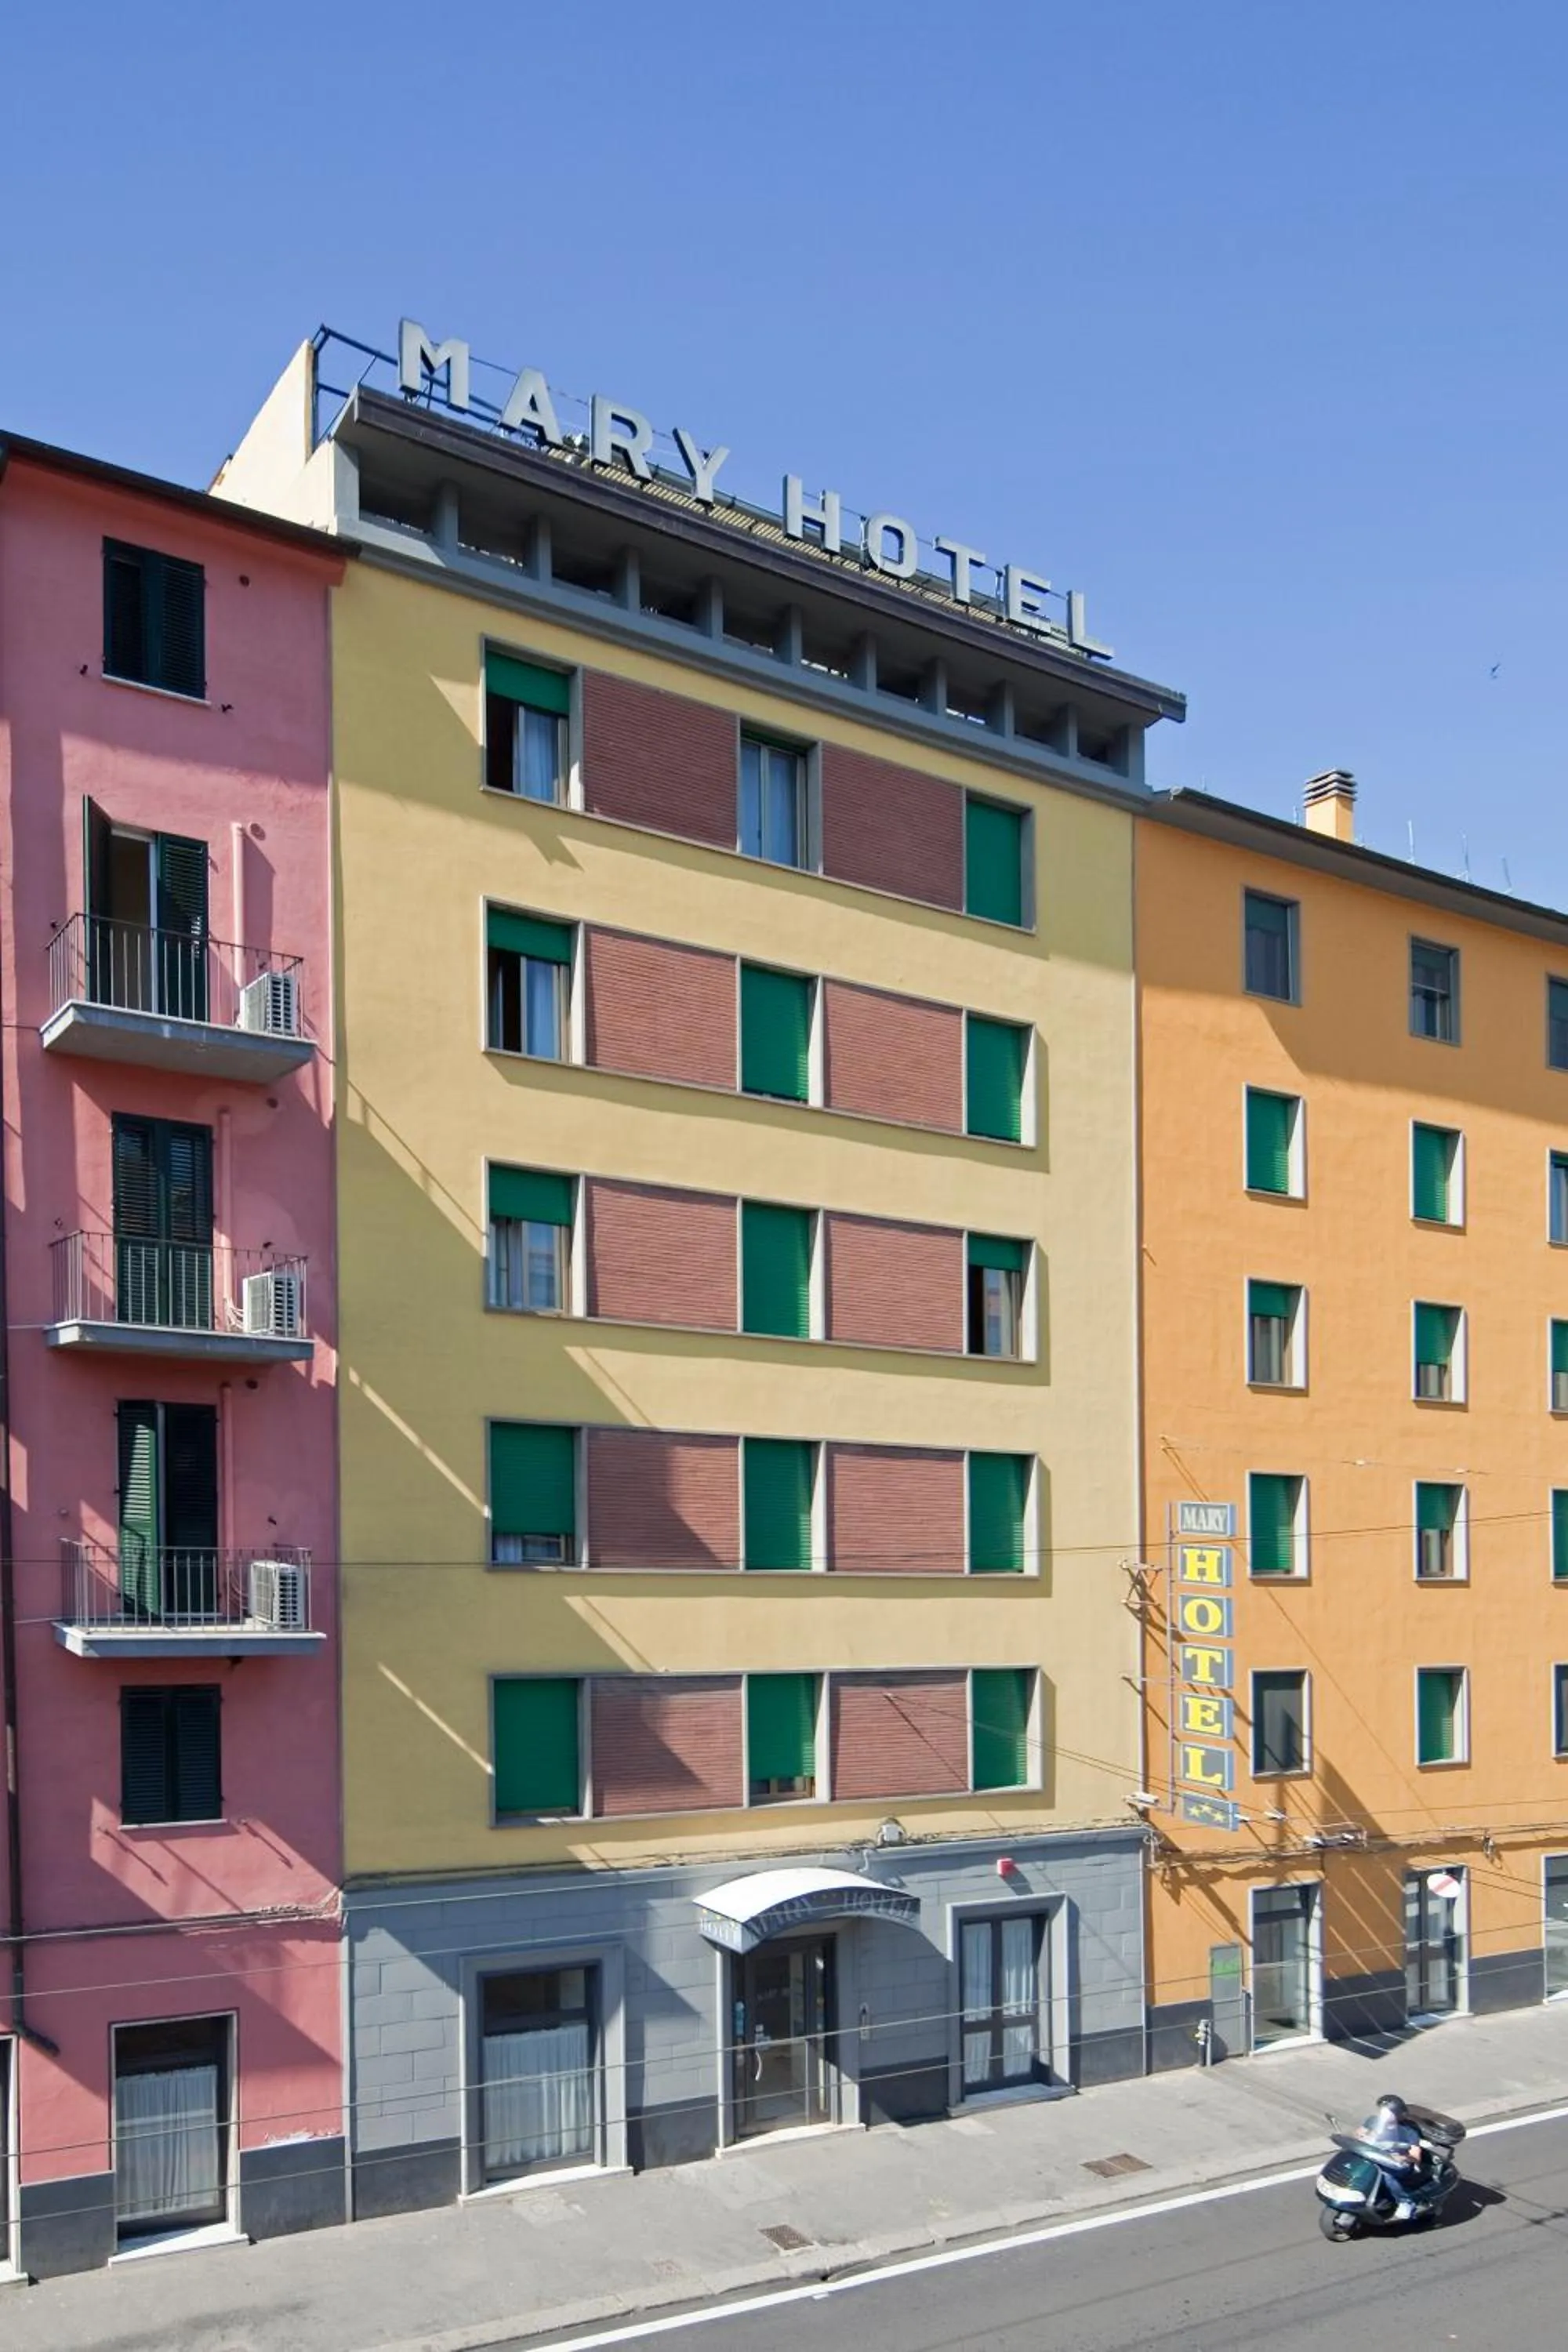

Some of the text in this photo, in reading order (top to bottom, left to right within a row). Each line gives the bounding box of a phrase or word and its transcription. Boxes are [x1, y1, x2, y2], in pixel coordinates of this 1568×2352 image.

[398, 317, 1115, 660] MARY HOTEL
[1182, 1506, 1227, 1532] MARY
[1182, 1548, 1223, 1788] HOTEL
[842, 1890, 916, 1923] HOTEL
